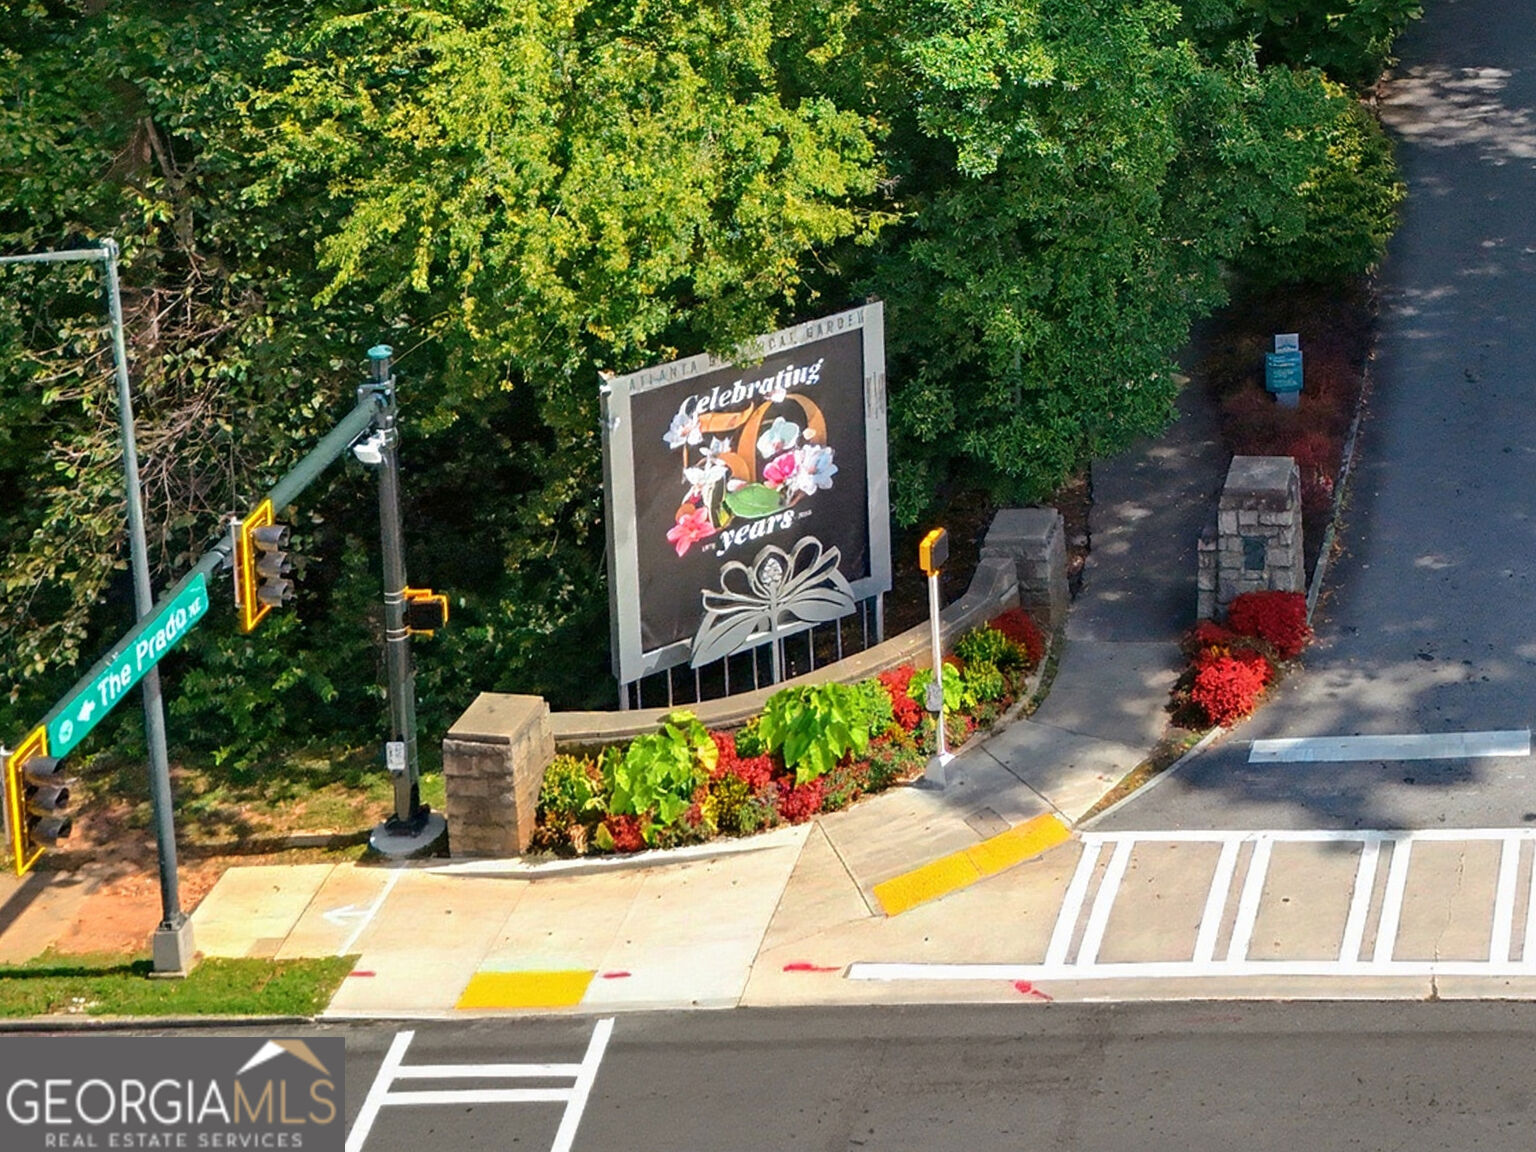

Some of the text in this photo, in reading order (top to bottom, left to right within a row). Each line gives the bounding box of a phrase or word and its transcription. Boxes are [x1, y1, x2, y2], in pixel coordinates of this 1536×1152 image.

[677, 358, 824, 418] Celebrating
[716, 509, 795, 557] years
[97, 663, 132, 706] The
[136, 608, 187, 671] Prado
